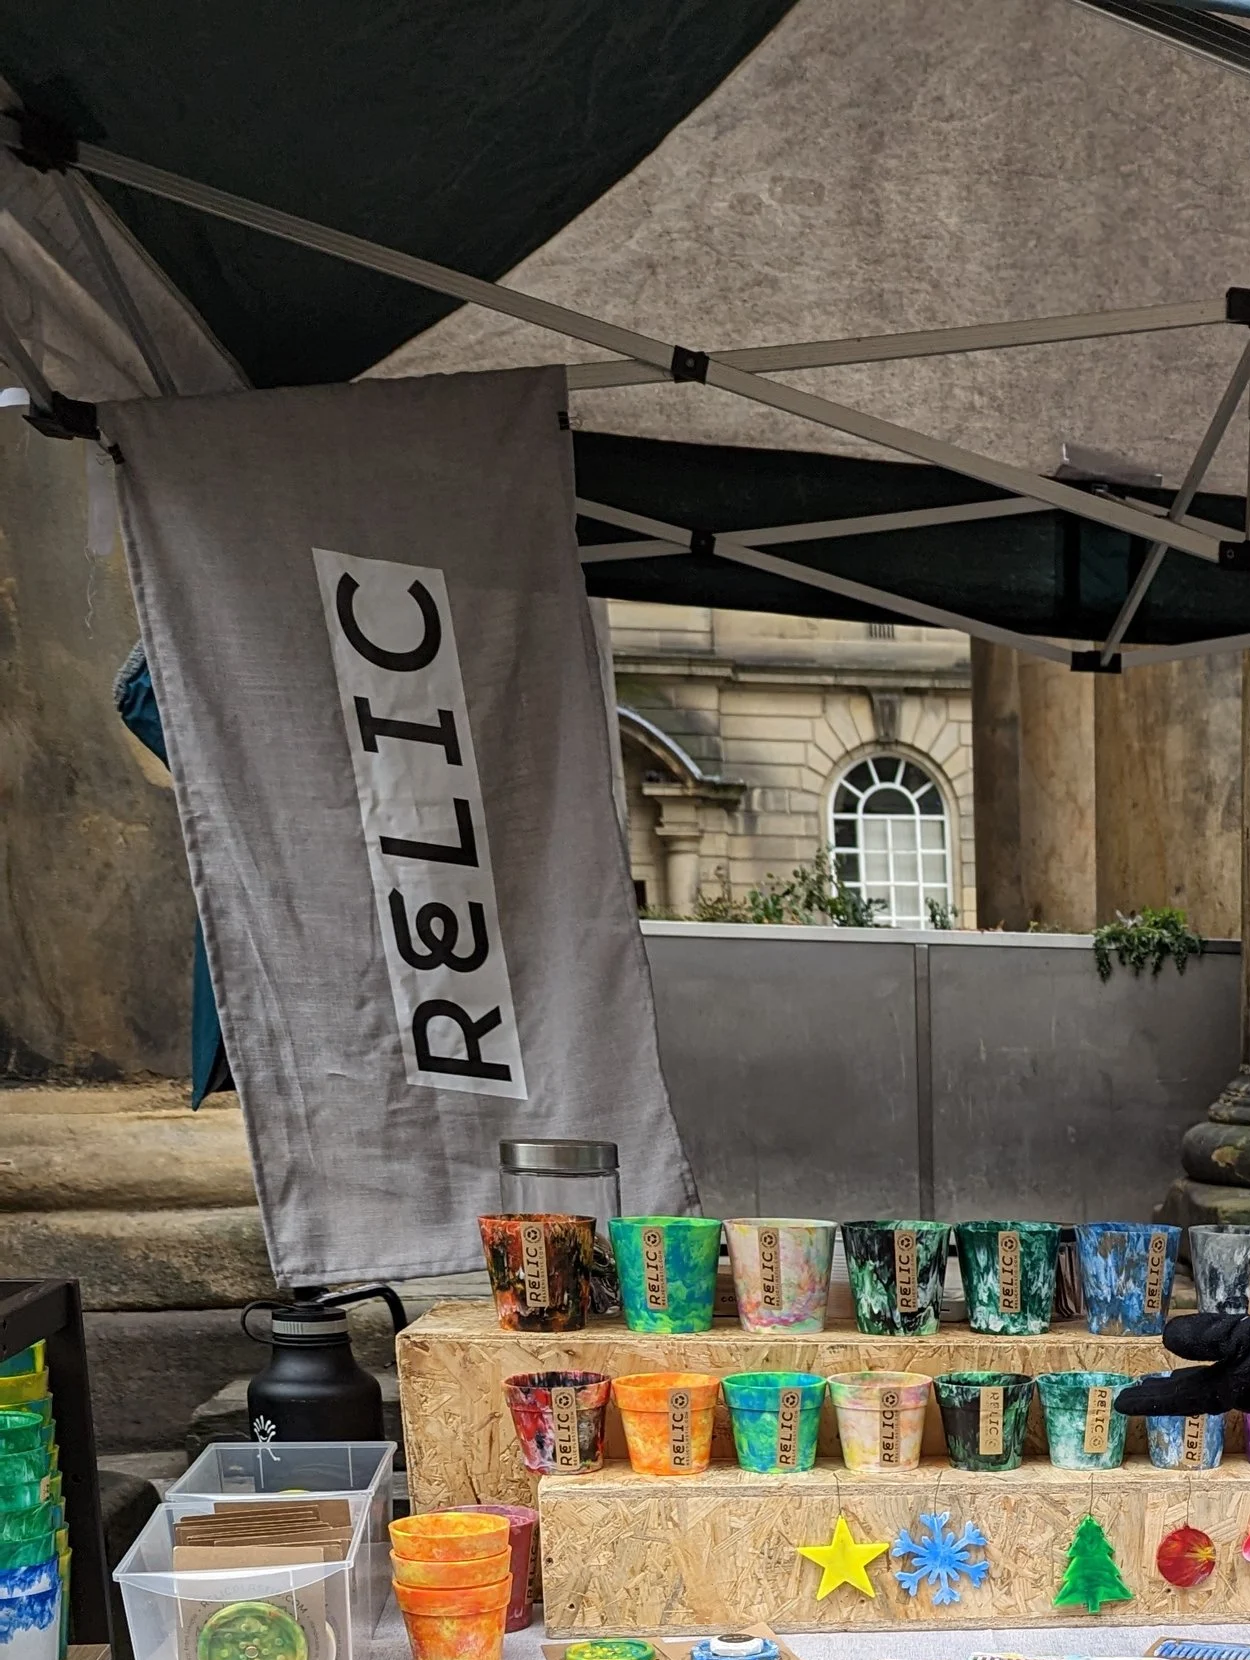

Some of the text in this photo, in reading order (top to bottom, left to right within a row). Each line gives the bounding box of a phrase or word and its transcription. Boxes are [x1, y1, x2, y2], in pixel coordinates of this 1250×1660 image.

[336, 572, 511, 1082] RELIC
[526, 1246, 542, 1302] RELIC
[646, 1250, 662, 1306] RELIC
[762, 1251, 776, 1306] RELIC
[898, 1254, 912, 1308] RELIC
[1002, 1255, 1014, 1310] RELIC
[1146, 1256, 1161, 1310] RELIC
[780, 1411, 794, 1464] RELIC
[882, 1410, 894, 1464] RELIC
[1094, 1389, 1108, 1434] RELIC
[558, 1412, 573, 1466] RELIC
[672, 1413, 685, 1466] RELIC
